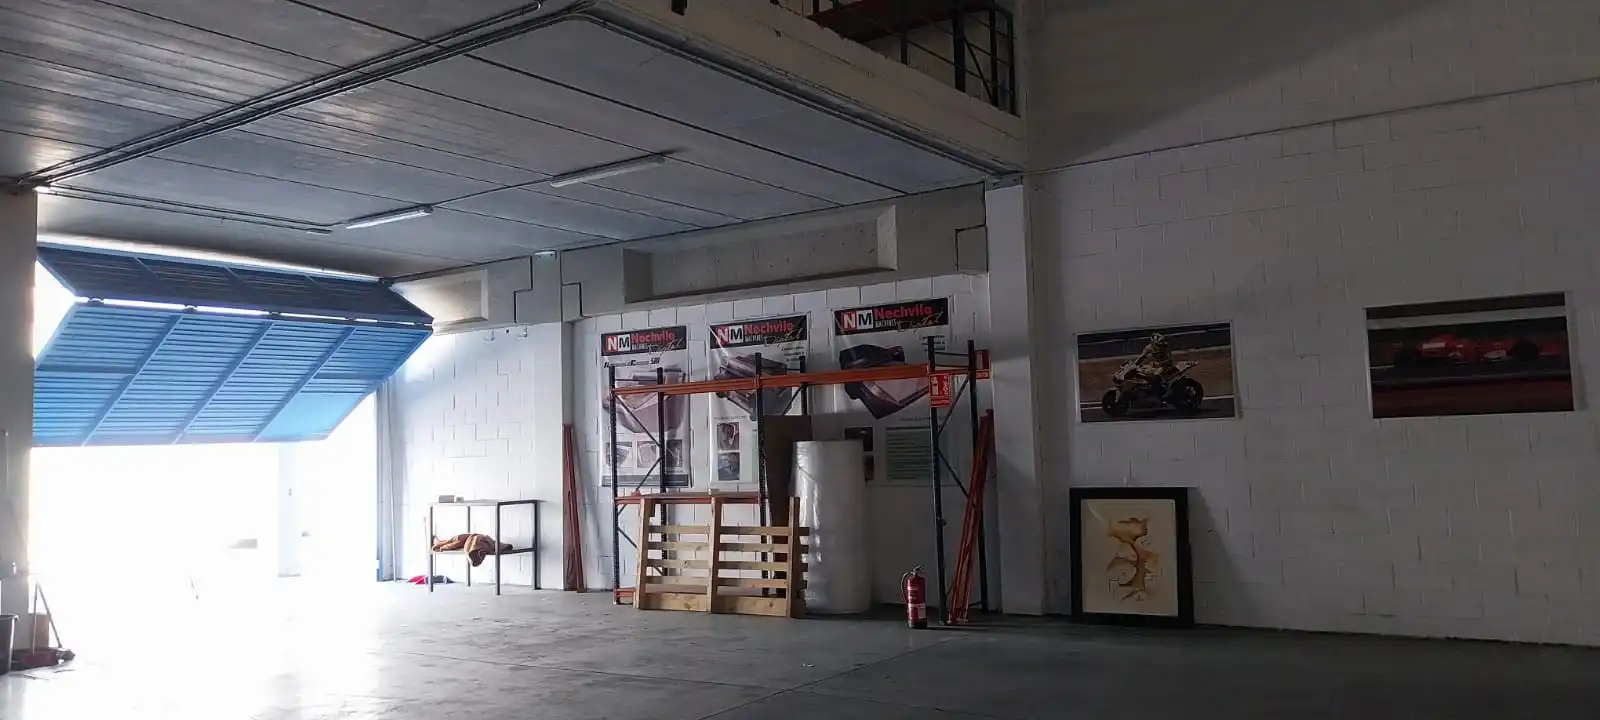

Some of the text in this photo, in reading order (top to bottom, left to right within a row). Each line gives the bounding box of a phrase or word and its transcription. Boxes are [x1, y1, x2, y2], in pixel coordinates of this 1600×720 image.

[843, 312, 872, 329] NM
[607, 335, 630, 351] NM
[717, 326, 743, 344] NM
